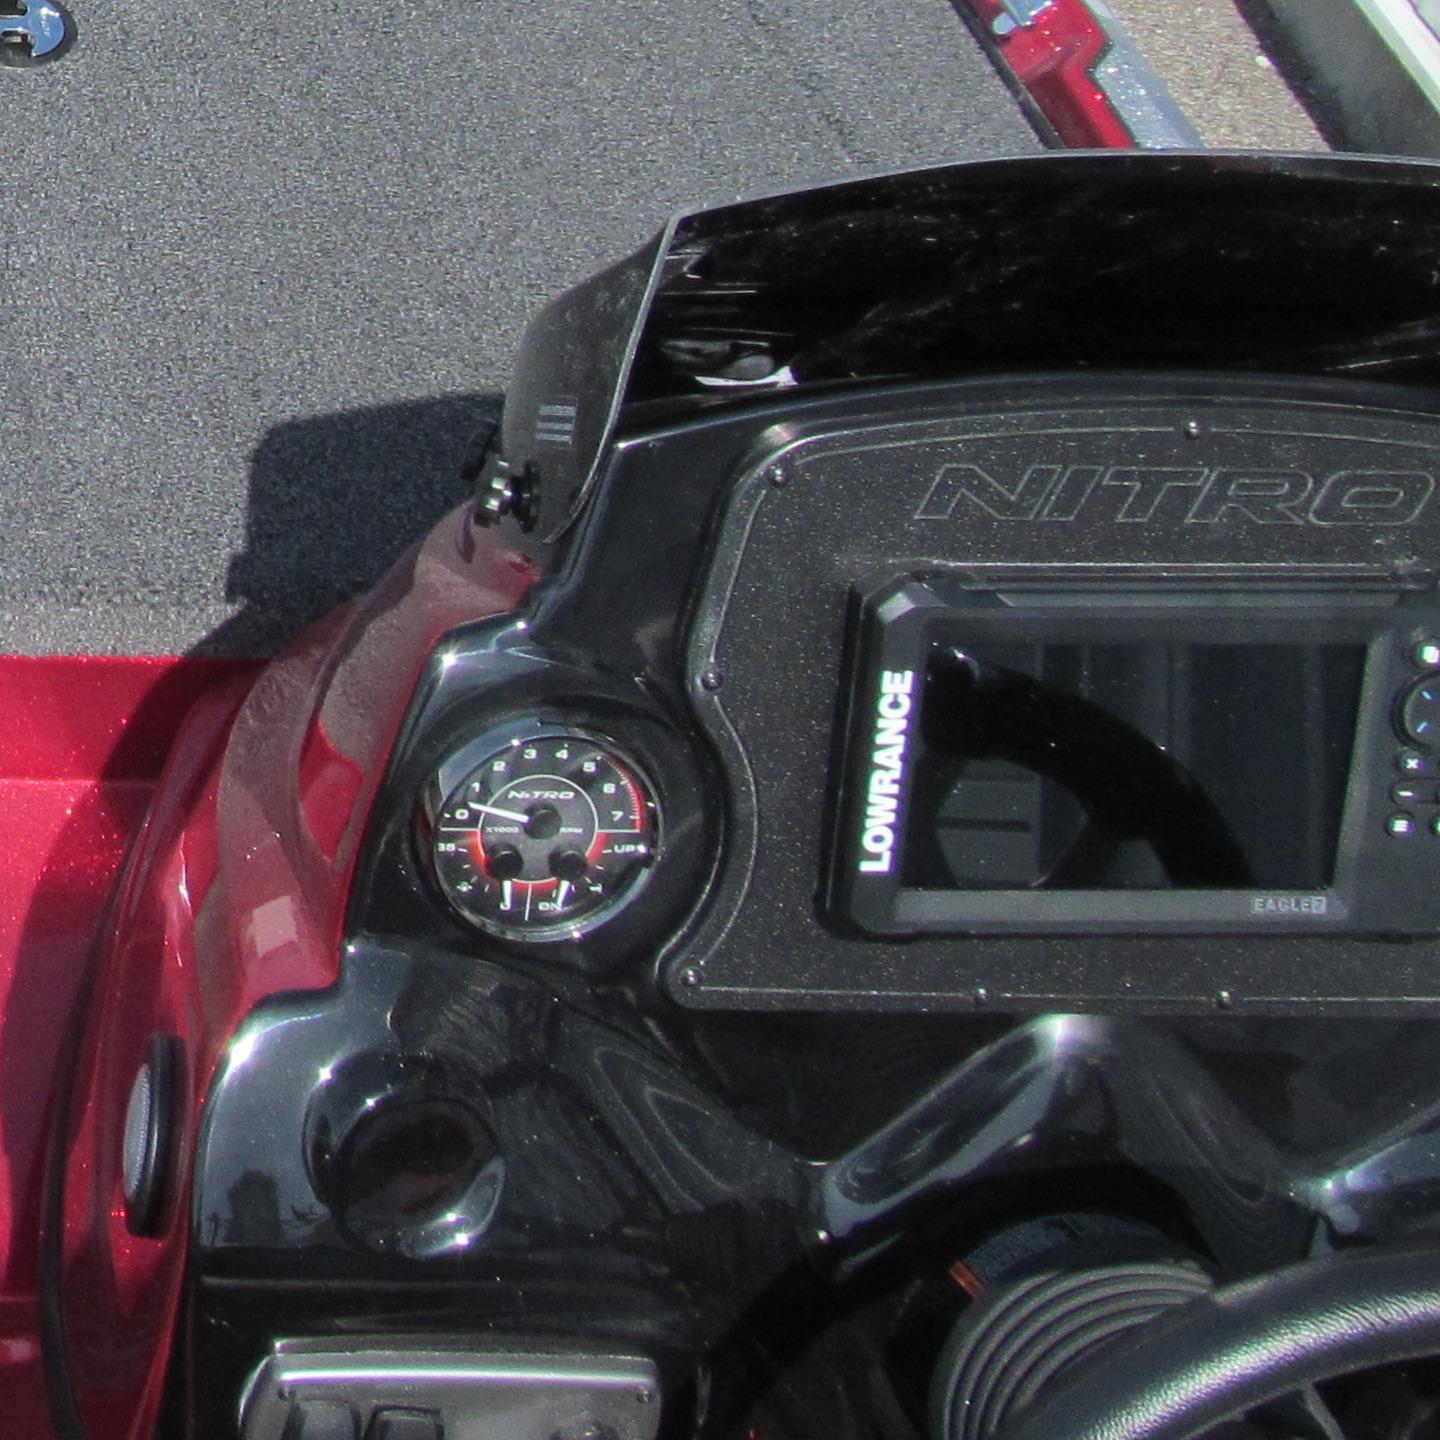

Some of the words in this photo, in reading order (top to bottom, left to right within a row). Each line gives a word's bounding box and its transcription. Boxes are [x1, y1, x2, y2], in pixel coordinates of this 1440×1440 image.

[913, 464, 1436, 526] NITRO
[523, 749, 537, 759] 3
[555, 749, 569, 760] 4
[493, 761, 506, 772] 2
[583, 762, 597, 773] 5
[858, 670, 914, 873] LOWRANCE
[471, 782, 481, 793] 1
[602, 783, 617, 794] 6
[455, 809, 469, 820] 0
[610, 810, 624, 821] 7
